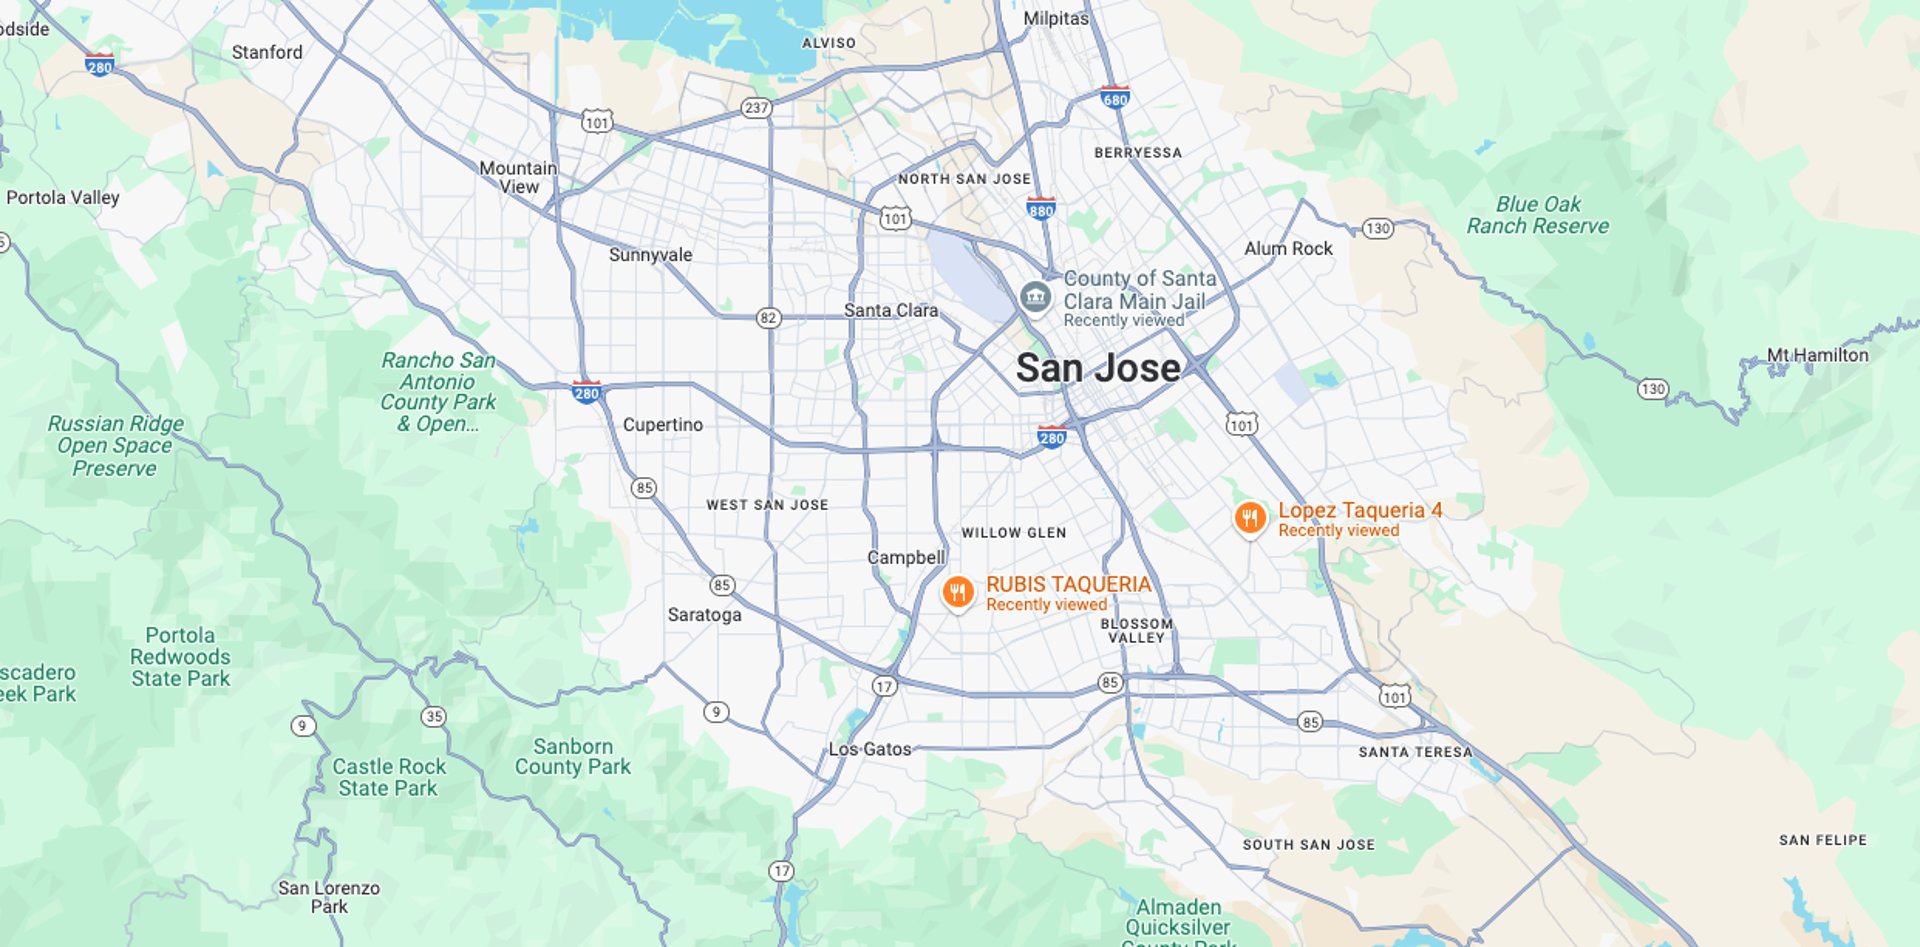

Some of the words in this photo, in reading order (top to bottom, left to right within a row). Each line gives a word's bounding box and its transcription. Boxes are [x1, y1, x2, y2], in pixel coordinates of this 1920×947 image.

[1024, 11, 1089, 28] Milpitas
[802, 38, 856, 48] ALVISO
[232, 45, 303, 59] Stanford
[89, 62, 112, 73] 280
[1104, 95, 1127, 106] 680
[746, 103, 768, 113] 237
[587, 118, 608, 128] 101
[1095, 148, 1182, 158] BERRYESSA
[480, 161, 557, 175] Mountain
[898, 174, 950, 184] NORTH
[956, 174, 986, 184] SAN
[993, 174, 1031, 184] JOSE
[499, 180, 539, 193] View
[7, 190, 66, 204] Portola
[70, 190, 120, 207] Valley
[1496, 196, 1539, 212] Blue
[1545, 196, 1581, 212] Oak
[1030, 206, 1053, 217] 880
[885, 214, 907, 225] 101
[1467, 217, 1527, 233] Ranch
[1533, 218, 1610, 233] Reserve
[1367, 224, 1390, 234] 130
[1244, 241, 1287, 255] Alum
[1293, 241, 1334, 255] Rock
[609, 247, 693, 264] Sunnyvale
[1064, 270, 1131, 290] County
[1137, 270, 1156, 286] of
[1162, 270, 1216, 286] Santa
[1064, 294, 1112, 309] Clara
[1120, 294, 1166, 309] Main
[1172, 293, 1205, 309] Jail
[844, 303, 891, 317] Santa
[896, 303, 939, 317] Clara
[761, 313, 776, 323] 82
[1064, 314, 1128, 329] Recently
[1132, 314, 1184, 326] viewed
[381, 352, 454, 368] Rancho
[460, 352, 496, 368] San
[1767, 348, 1789, 361] Mt
[1794, 348, 1869, 362] Hamilton
[1016, 352, 1083, 382] San
[1094, 352, 1181, 382] Jose
[399, 374, 475, 389] Antonio
[575, 388, 598, 398] 280
[1643, 384, 1665, 395] 130
[381, 394, 449, 414] County
[453, 394, 496, 409] Park
[47, 416, 124, 431] Russian
[129, 416, 185, 435] Ridge
[397, 416, 412, 431] &
[417, 416, 478, 435] Open...
[623, 418, 704, 434] Cupertino
[1232, 420, 1253, 431] 101
[1041, 433, 1064, 444] 280
[58, 437, 108, 456] Open
[112, 437, 172, 457] Space
[72, 460, 157, 476] Preserve
[637, 483, 652, 493] 85
[706, 500, 747, 510] WEST
[754, 500, 784, 510] SAN
[790, 500, 828, 510] JOSE
[1279, 502, 1337, 521] Lopez
[1342, 502, 1425, 522] Taqueria
[1431, 502, 1443, 517] 4
[961, 528, 1021, 538] WILLOW
[1027, 528, 1066, 538] GLEN
[1279, 524, 1343, 539] Recently
[1347, 524, 1400, 536] viewed
[867, 550, 945, 567] Campbell
[715, 580, 730, 591] 85
[987, 576, 1046, 592] RUBIS
[1051, 576, 1152, 594] TAQUERIA
[987, 598, 1051, 612] Recently
[1055, 598, 1107, 610] viewed
[668, 608, 742, 624] Saratoga
[1101, 619, 1173, 629] BLOSSOM
[146, 627, 215, 643] Portola
[1108, 633, 1165, 643] VALLEY
[131, 648, 231, 664] Redwoods
[0, 664, 76, 680] scadero
[132, 670, 182, 686] State
[188, 670, 230, 686] Park
[878, 682, 892, 692] 17
[1103, 677, 1118, 688] 85
[33, 686, 77, 701] Park
[1384, 692, 1406, 703] 101
[427, 712, 443, 722] 35
[712, 707, 721, 717] 9
[298, 721, 306, 731] 9
[1304, 717, 1319, 728] 85
[534, 738, 613, 754] Sanborn
[829, 742, 859, 756] Los
[863, 742, 912, 755] Gatos
[1359, 747, 1409, 757] SANTA
[1416, 747, 1473, 757] TERESA
[333, 758, 393, 774] Castle
[399, 758, 446, 774] Rock
[515, 759, 582, 778] County
[589, 758, 631, 774] Park
[339, 780, 389, 796] State
[395, 780, 438, 796] Park
[1243, 840, 1294, 850] SOUTH
[1300, 840, 1331, 850] SAN
[1336, 840, 1375, 850] JOSE
[1779, 835, 1810, 845] SAN
[1816, 835, 1867, 845] FELIPE
[775, 866, 789, 876] 17
[279, 881, 310, 895] San
[315, 882, 380, 895] Lorenzo
[311, 899, 348, 913] Park
[1136, 899, 1221, 914] Almaden
[1126, 919, 1230, 936] Quicksilver
